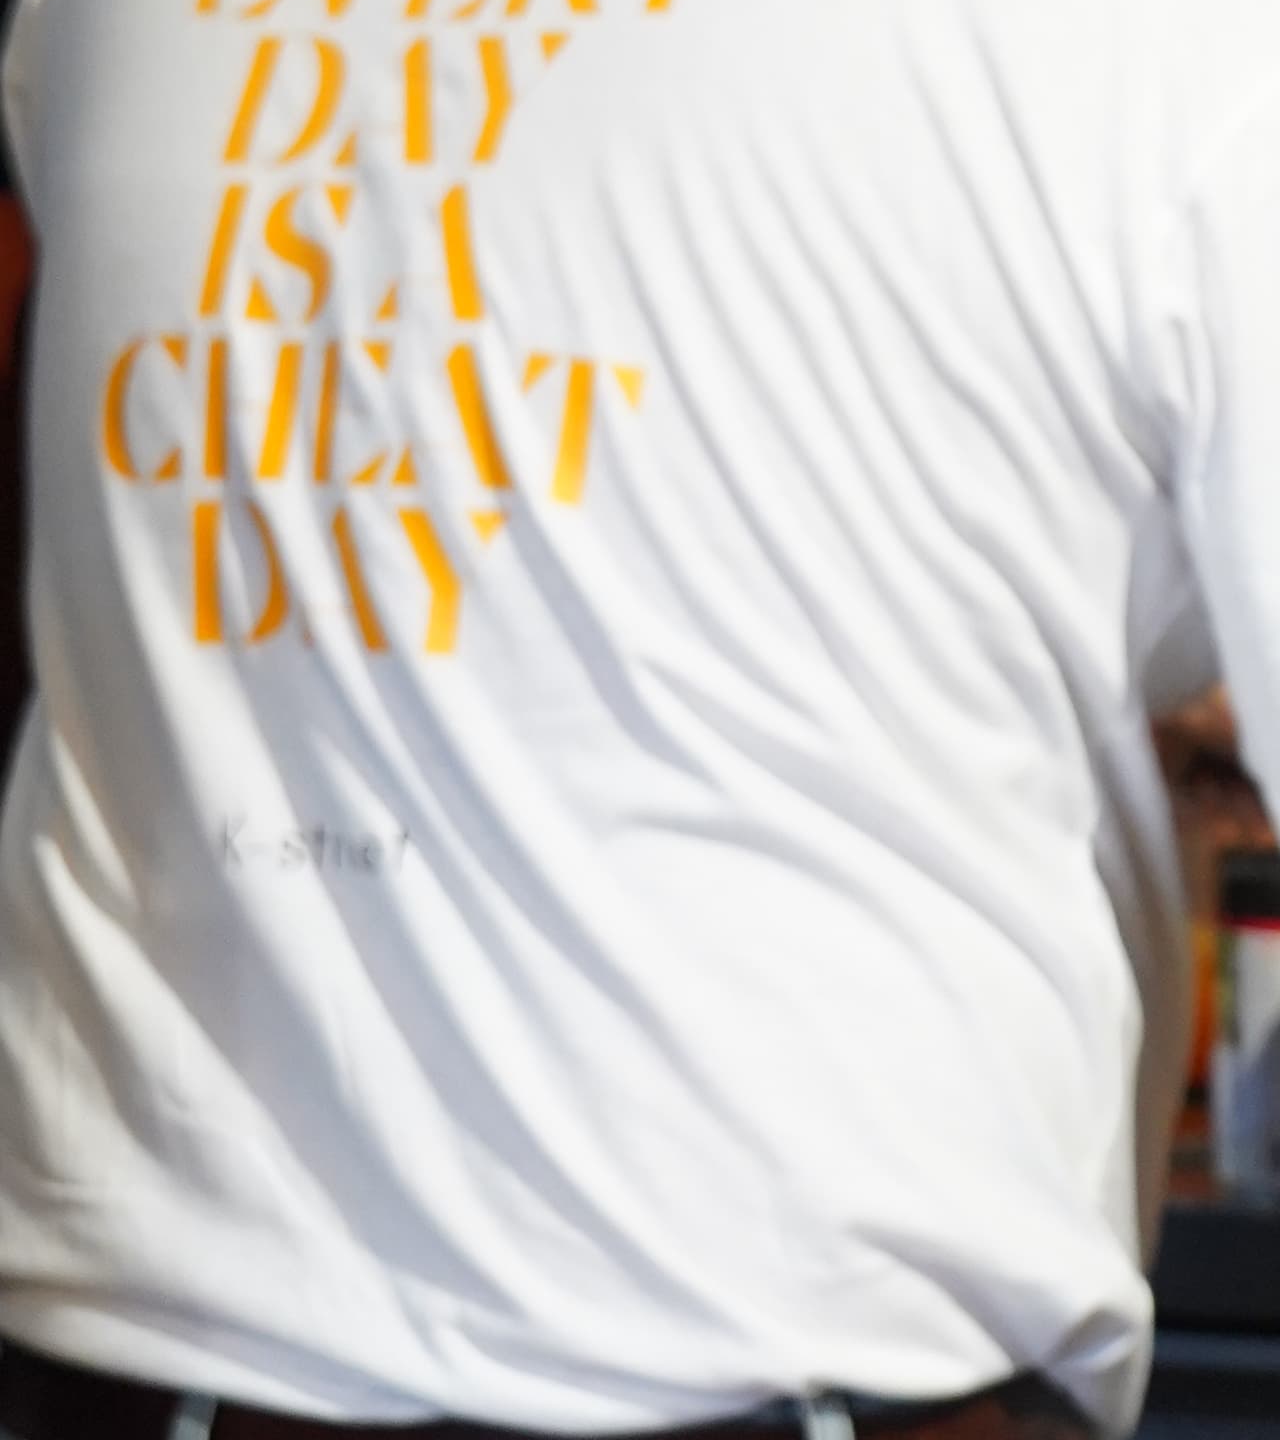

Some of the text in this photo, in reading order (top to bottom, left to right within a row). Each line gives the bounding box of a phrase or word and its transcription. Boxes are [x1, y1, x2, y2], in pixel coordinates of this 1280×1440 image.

[222, 31, 571, 167] DAY
[197, 182, 486, 323] IS A
[100, 334, 645, 506] CHEAT
[191, 496, 508, 655] DAY
